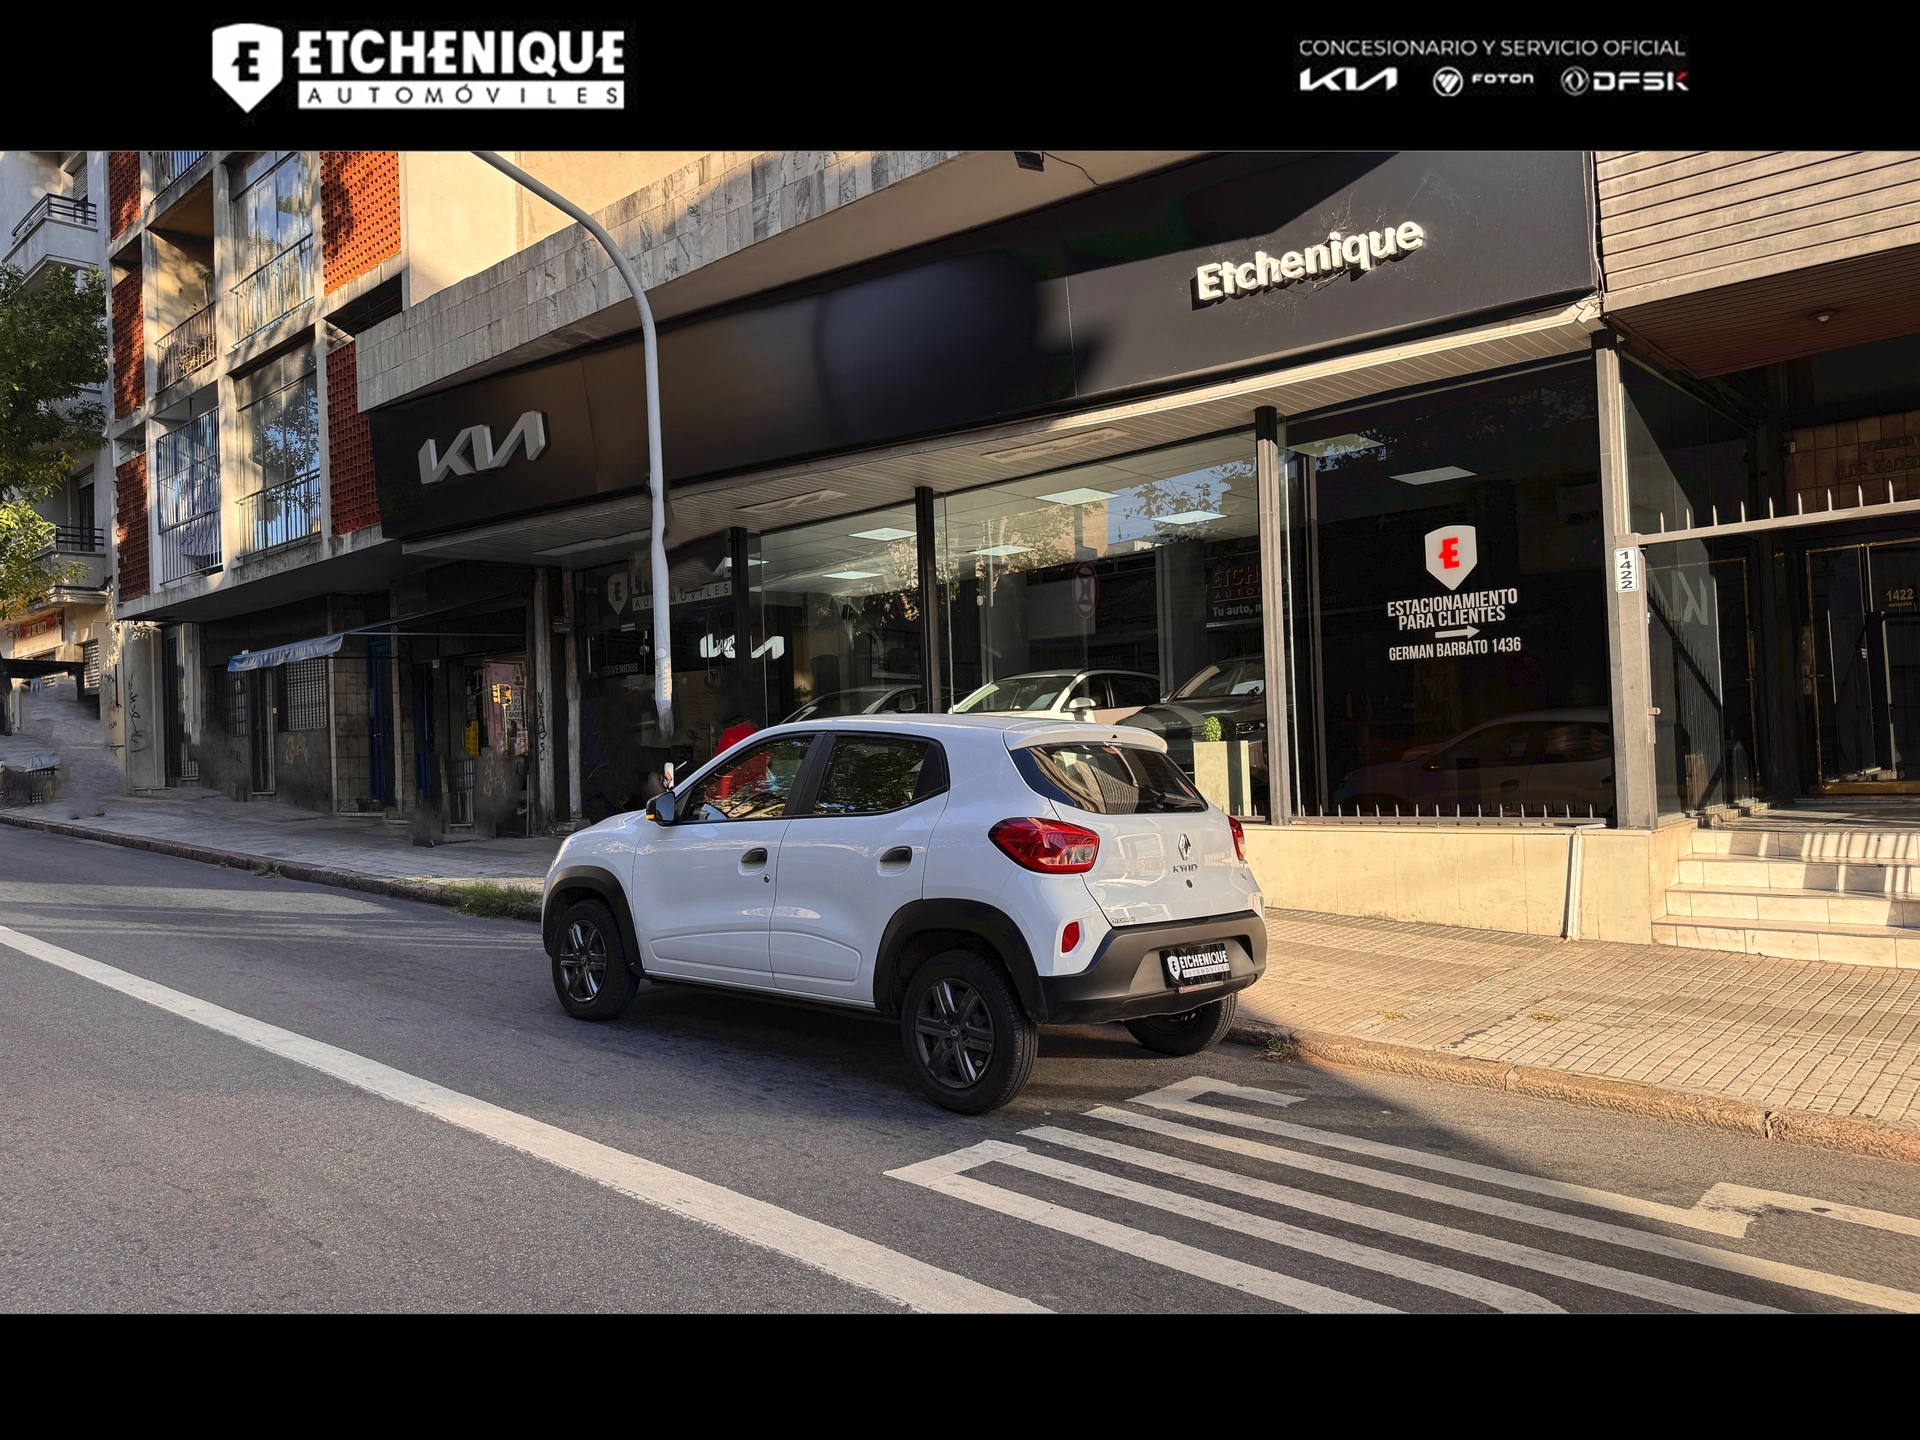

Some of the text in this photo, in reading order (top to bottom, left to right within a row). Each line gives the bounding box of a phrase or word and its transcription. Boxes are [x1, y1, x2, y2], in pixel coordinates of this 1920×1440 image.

[1197, 220, 1424, 301] Etchenique
[418, 410, 546, 485] KIA
[1839, 454, 1920, 479] LOS MADRO
[1619, 551, 1633, 590] 1422
[1387, 588, 1518, 617] ESTACIONAMIENTO
[1886, 588, 1914, 602] 1422
[1399, 605, 1506, 631] PARA CLIENTES
[1388, 636, 1522, 662] GERMAN BARBATO 1436
[1178, 950, 1229, 969] ETCHENIQUE
